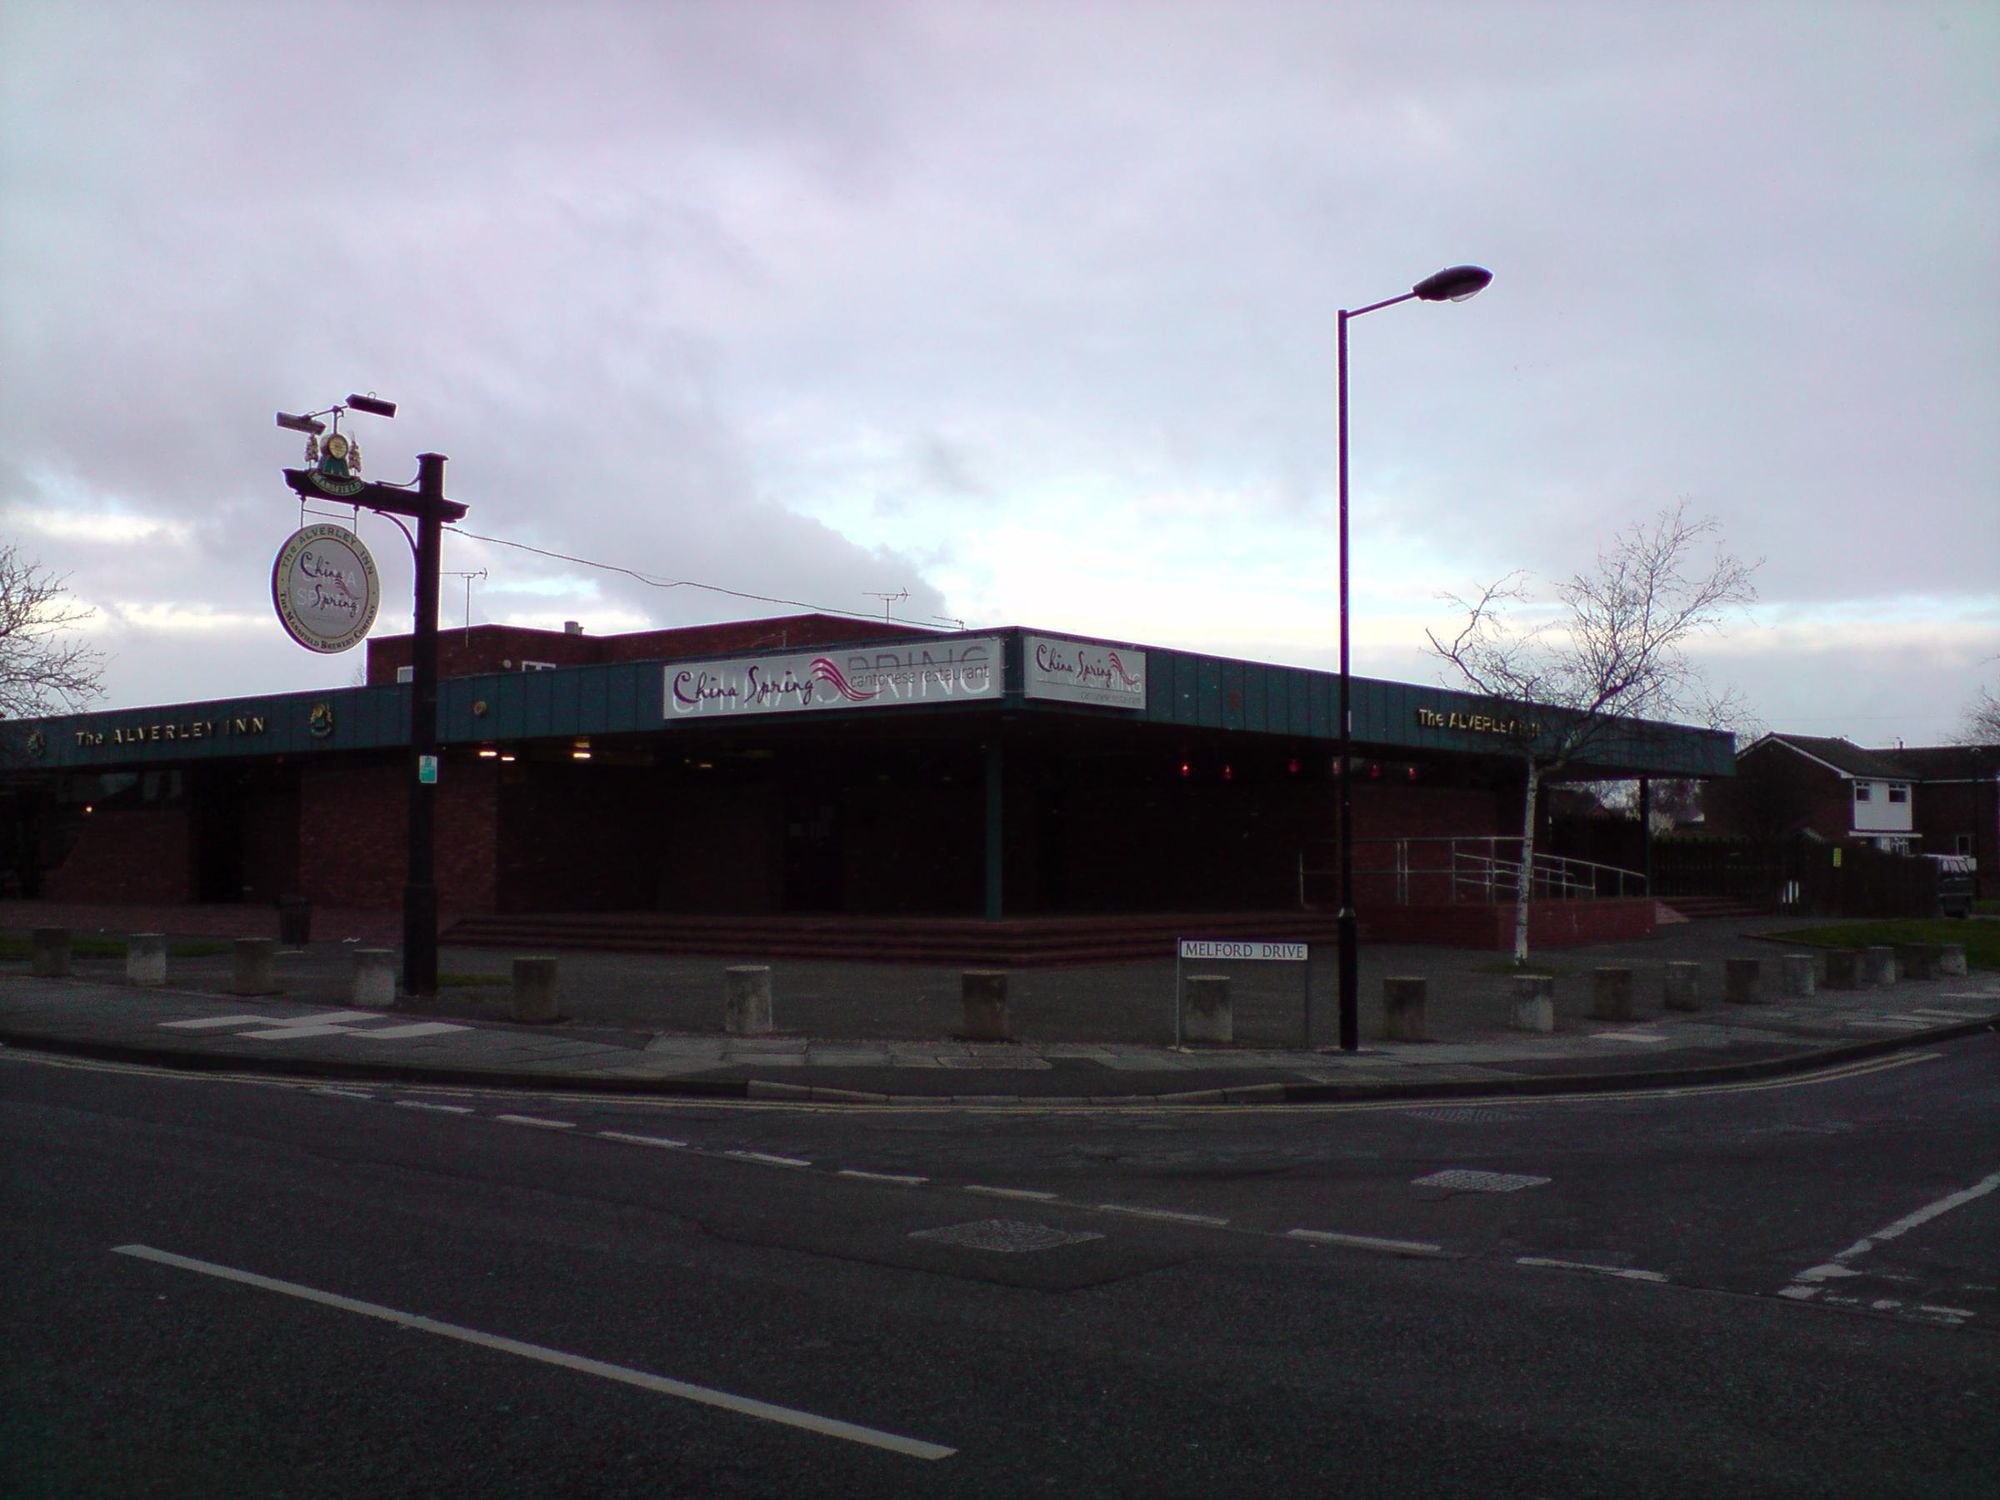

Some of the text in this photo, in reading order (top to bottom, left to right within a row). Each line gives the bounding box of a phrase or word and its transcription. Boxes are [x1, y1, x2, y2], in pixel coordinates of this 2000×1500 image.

[300, 526, 356, 544] ALVERLEY
[360, 550, 375, 576] INN
[300, 551, 344, 578] China
[312, 583, 358, 618] Spring
[850, 663, 990, 688] cantonese restaurant
[1036, 643, 1113, 688] China Spring
[672, 664, 814, 705] China Spring
[76, 716, 264, 746] The ALVERLEY INN
[1419, 708, 1444, 727] The
[1185, 942, 1304, 959] MELFORD DRIVE
